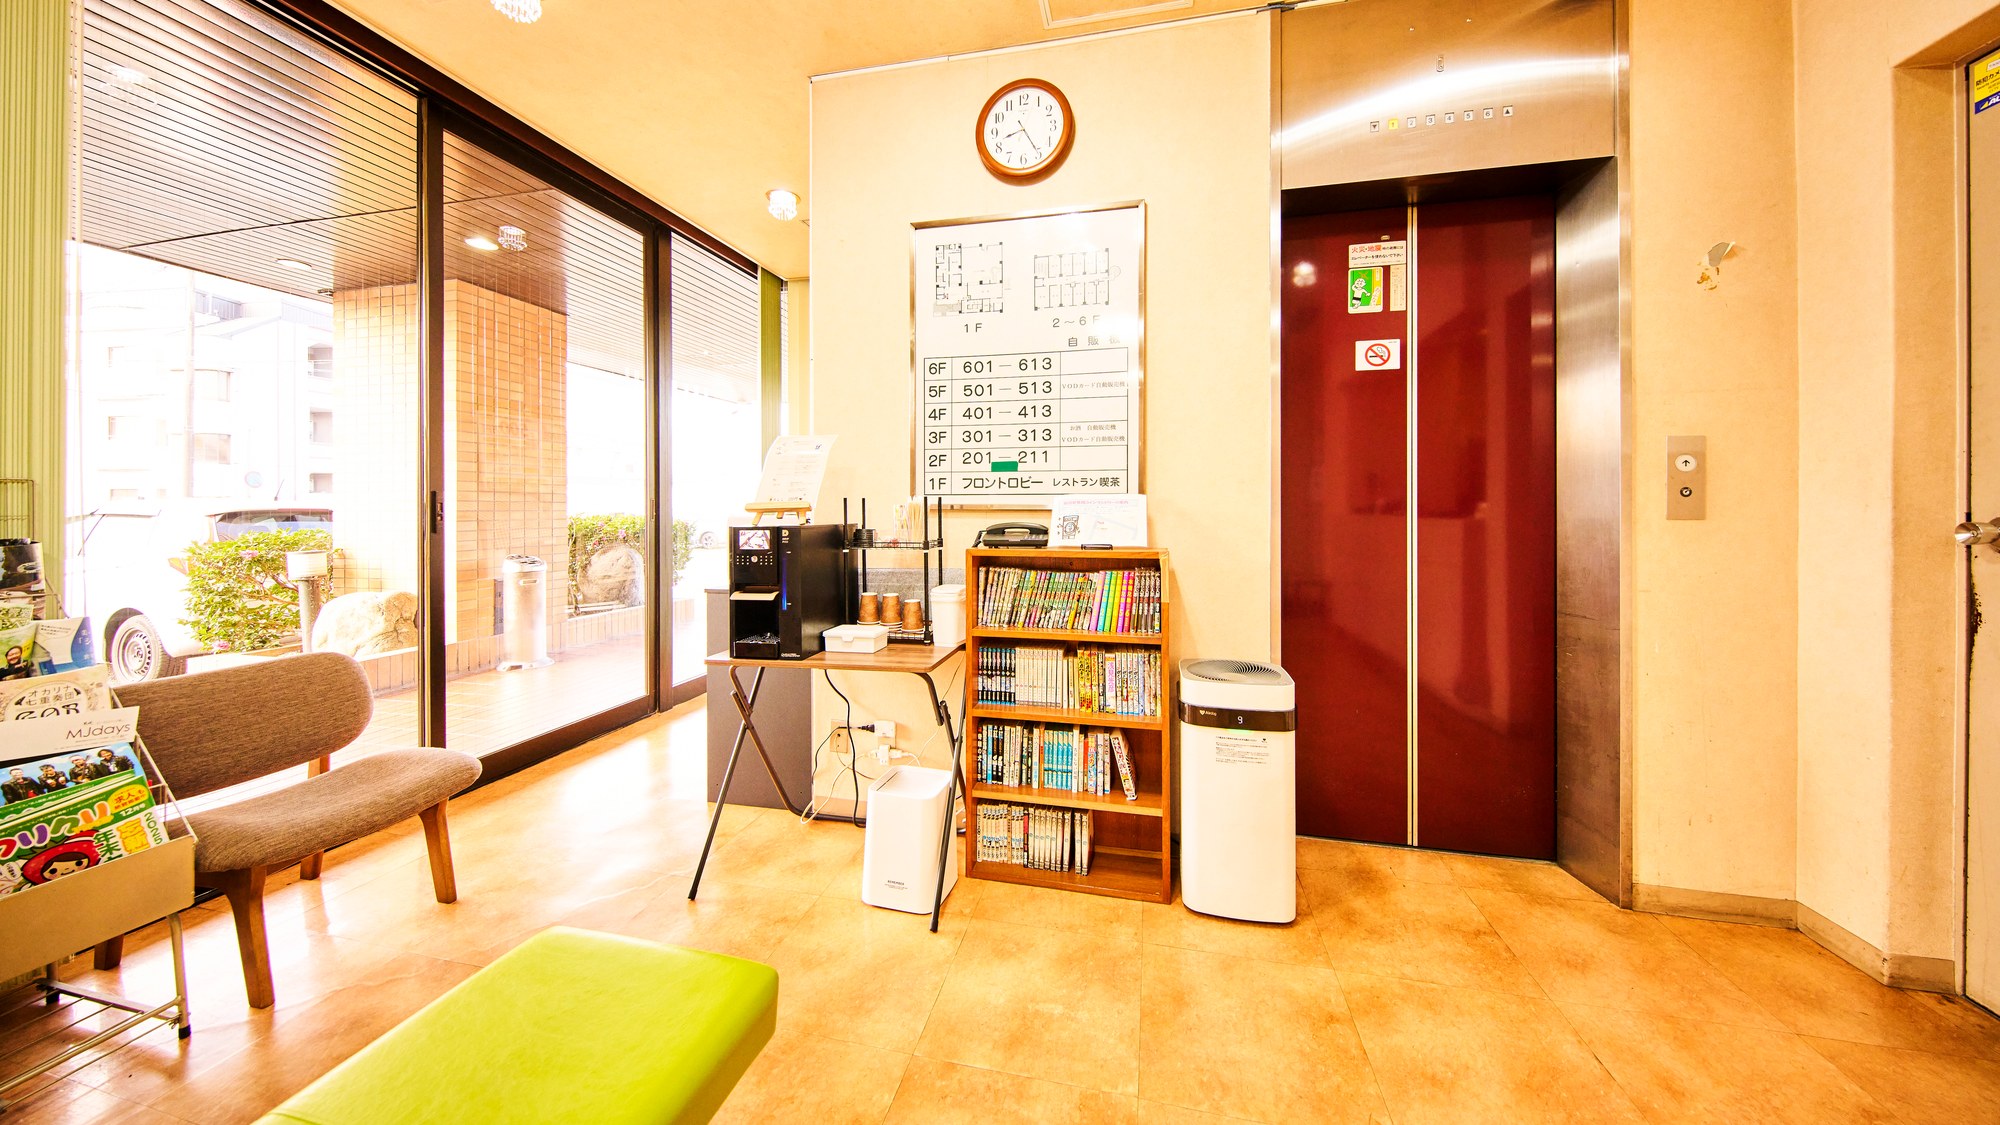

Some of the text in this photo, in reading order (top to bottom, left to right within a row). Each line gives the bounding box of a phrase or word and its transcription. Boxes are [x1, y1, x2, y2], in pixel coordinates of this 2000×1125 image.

[1006, 99, 1013, 111] 11
[1019, 93, 1029, 106] 12
[1045, 104, 1053, 117] 2
[995, 112, 1004, 124] 10
[1049, 119, 1057, 132] 3
[991, 127, 999, 140] 9
[995, 142, 1003, 154] 8
[1035, 147, 1042, 160] 5
[1006, 151, 1012, 164] 7
[1020, 153, 1027, 165] 6
[928, 362, 946, 375] 6F
[963, 360, 992, 373] 601
[1018, 357, 1052, 371] 613
[928, 385, 946, 398] 5F
[963, 383, 992, 397] 501
[1018, 380, 1052, 394] 513
[928, 408, 947, 421] 4F
[962, 406, 992, 420] 401
[1018, 404, 1052, 418] 413
[928, 431, 947, 444] 3F
[962, 430, 992, 443] 301
[1018, 428, 1052, 442] 313
[928, 454, 947, 467] 2F
[962, 451, 992, 465] 201
[1018, 450, 1048, 464] 211
[929, 477, 947, 490] 1F
[1052, 476, 1120, 488] レストラン喫茶
[28, 684, 72, 698] オカリナ
[1237, 715, 1243, 725] 9
[66, 724, 131, 740] MJdays
[93, 828, 123, 863] 年末
